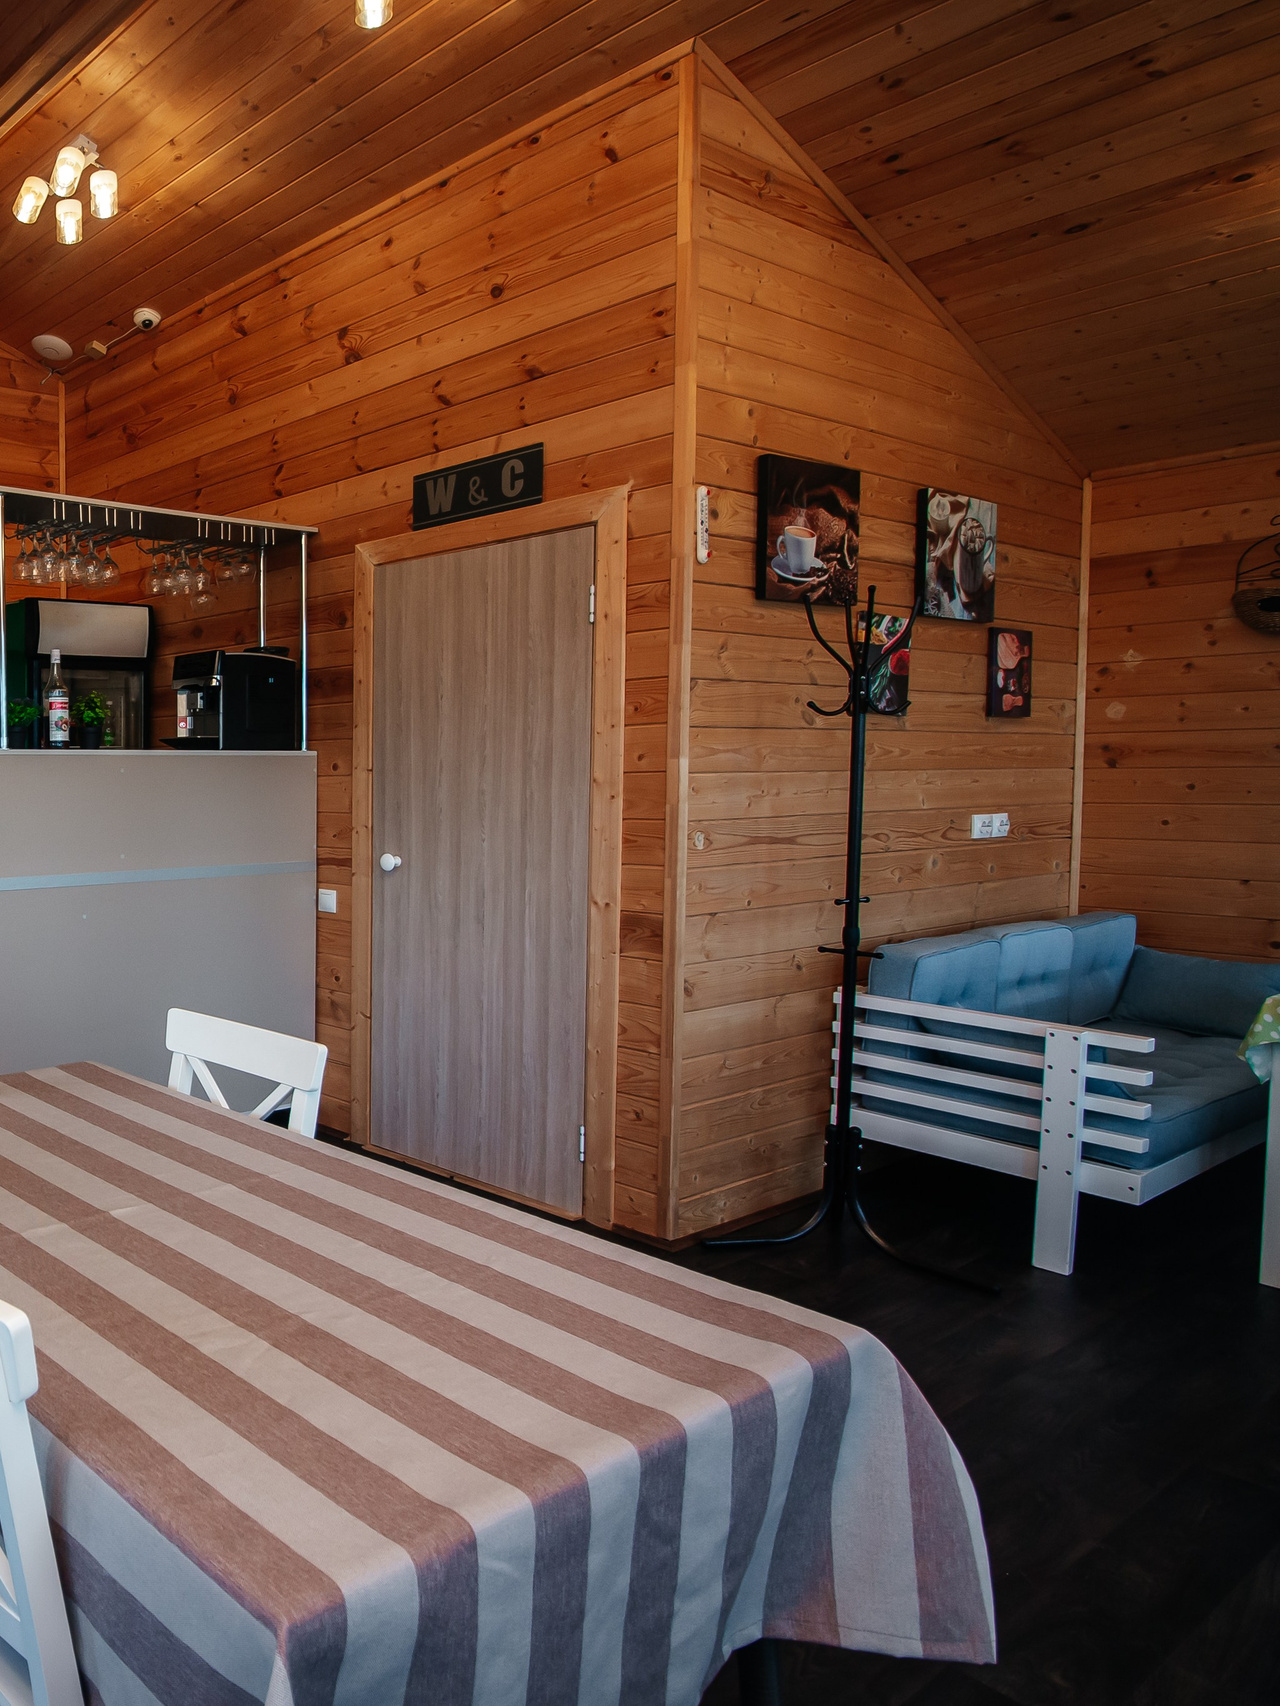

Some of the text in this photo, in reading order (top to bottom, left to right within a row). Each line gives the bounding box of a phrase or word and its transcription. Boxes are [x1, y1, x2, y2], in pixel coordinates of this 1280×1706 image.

[425, 458, 524, 515] W & C
